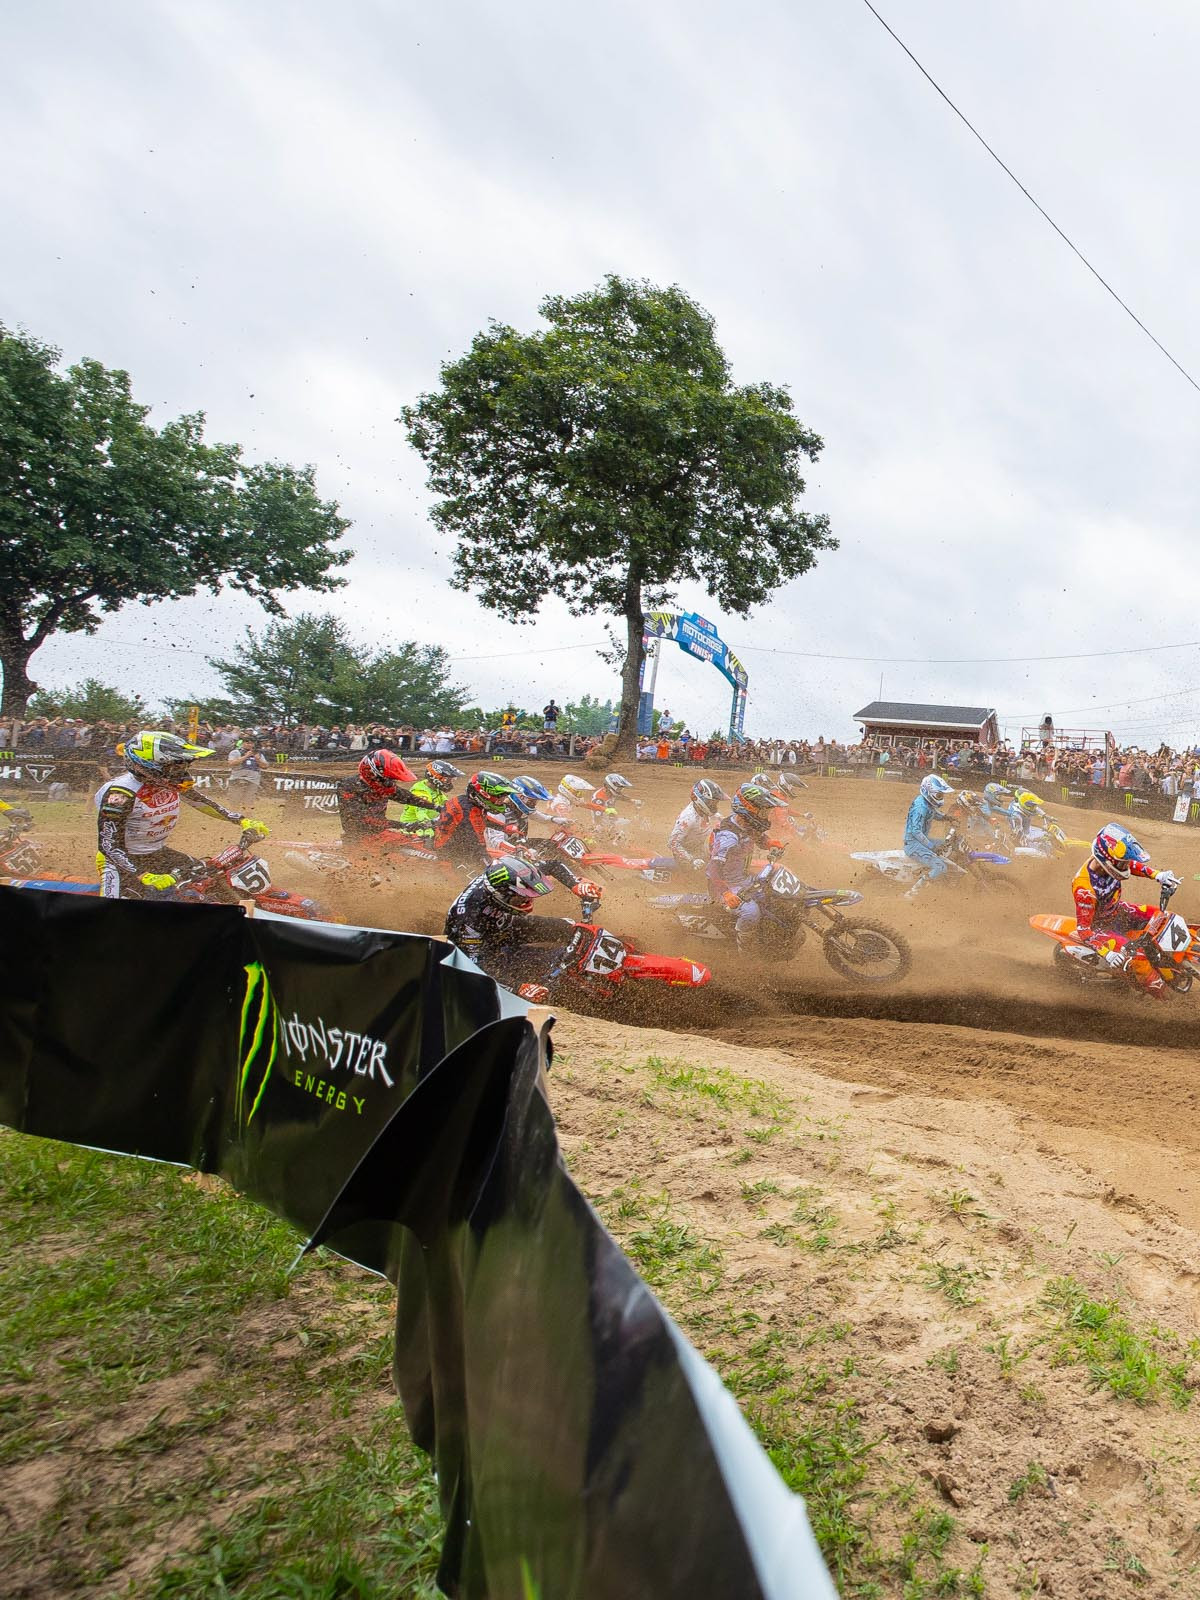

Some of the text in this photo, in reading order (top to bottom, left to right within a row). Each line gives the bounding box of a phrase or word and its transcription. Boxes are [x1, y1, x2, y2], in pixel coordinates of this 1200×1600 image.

[690, 641, 713, 661] FINISH
[237, 862, 272, 894] 51
[1170, 921, 1188, 951] 4
[294, 1069, 366, 1115] ENERGY
